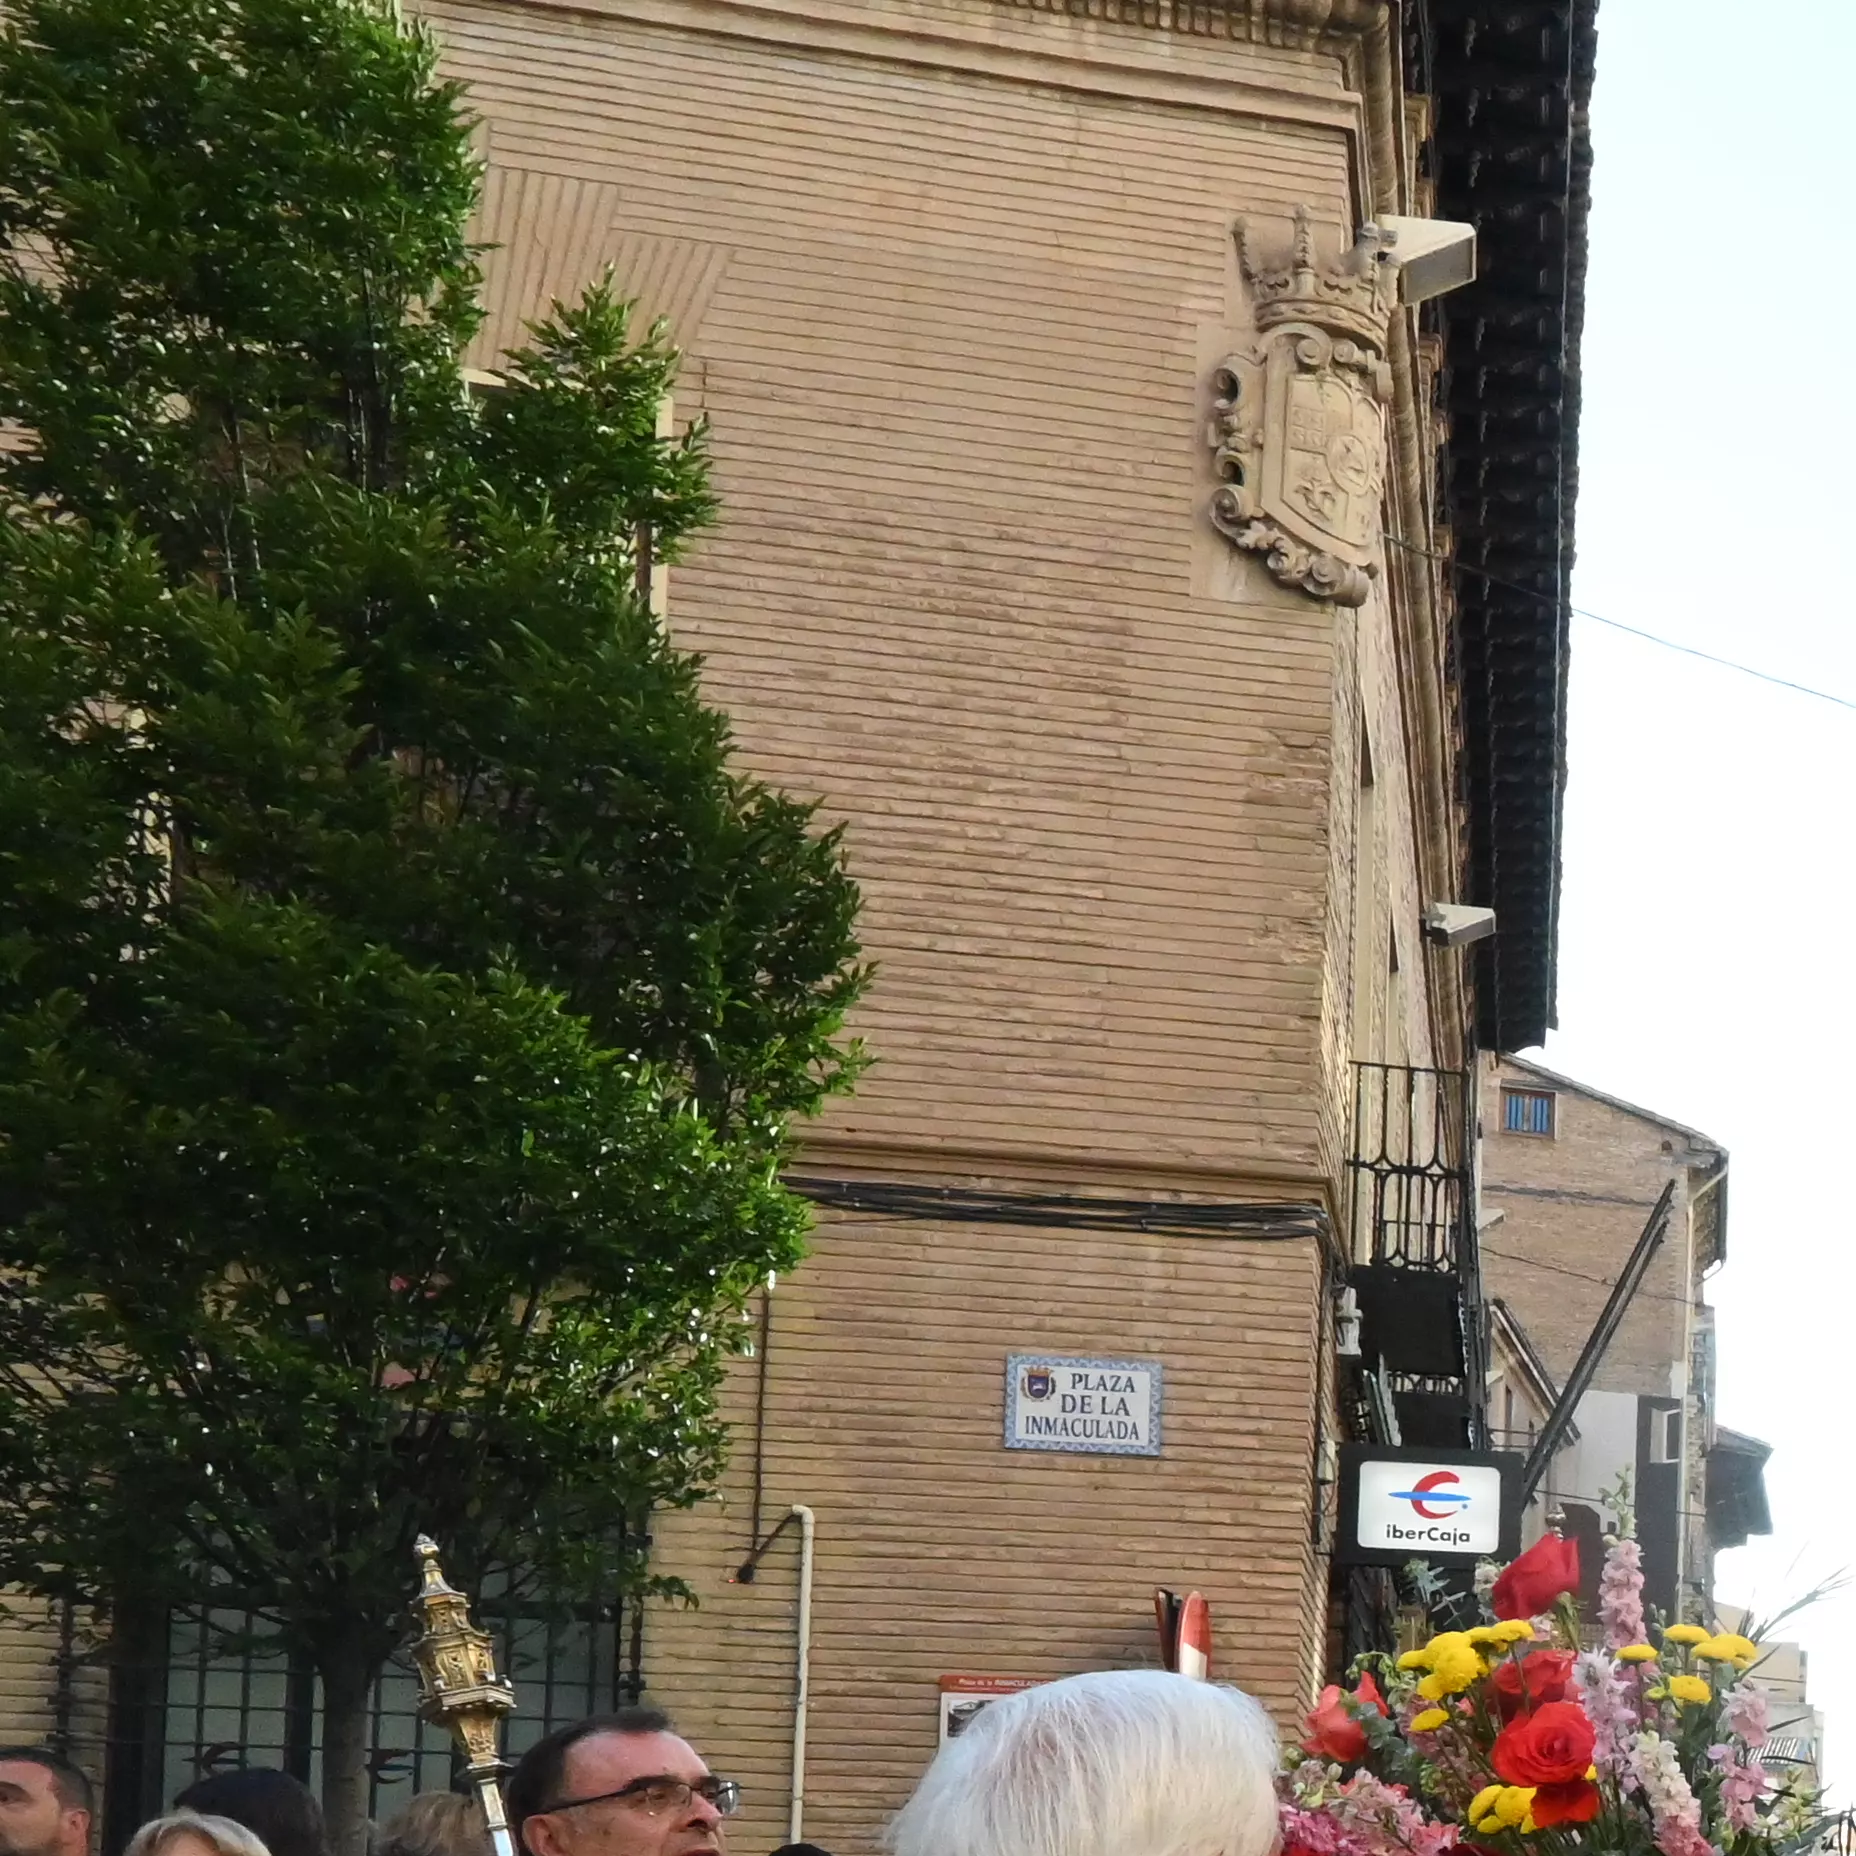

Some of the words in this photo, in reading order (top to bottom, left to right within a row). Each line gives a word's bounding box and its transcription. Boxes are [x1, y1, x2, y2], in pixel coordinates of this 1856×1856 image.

[1071, 1373, 1136, 1393] PLAZA
[1061, 1394, 1093, 1414] DE
[1101, 1396, 1130, 1416] LA
[1025, 1416, 1139, 1440] INMACULADA
[1386, 1524, 1470, 1546] iberCaja
